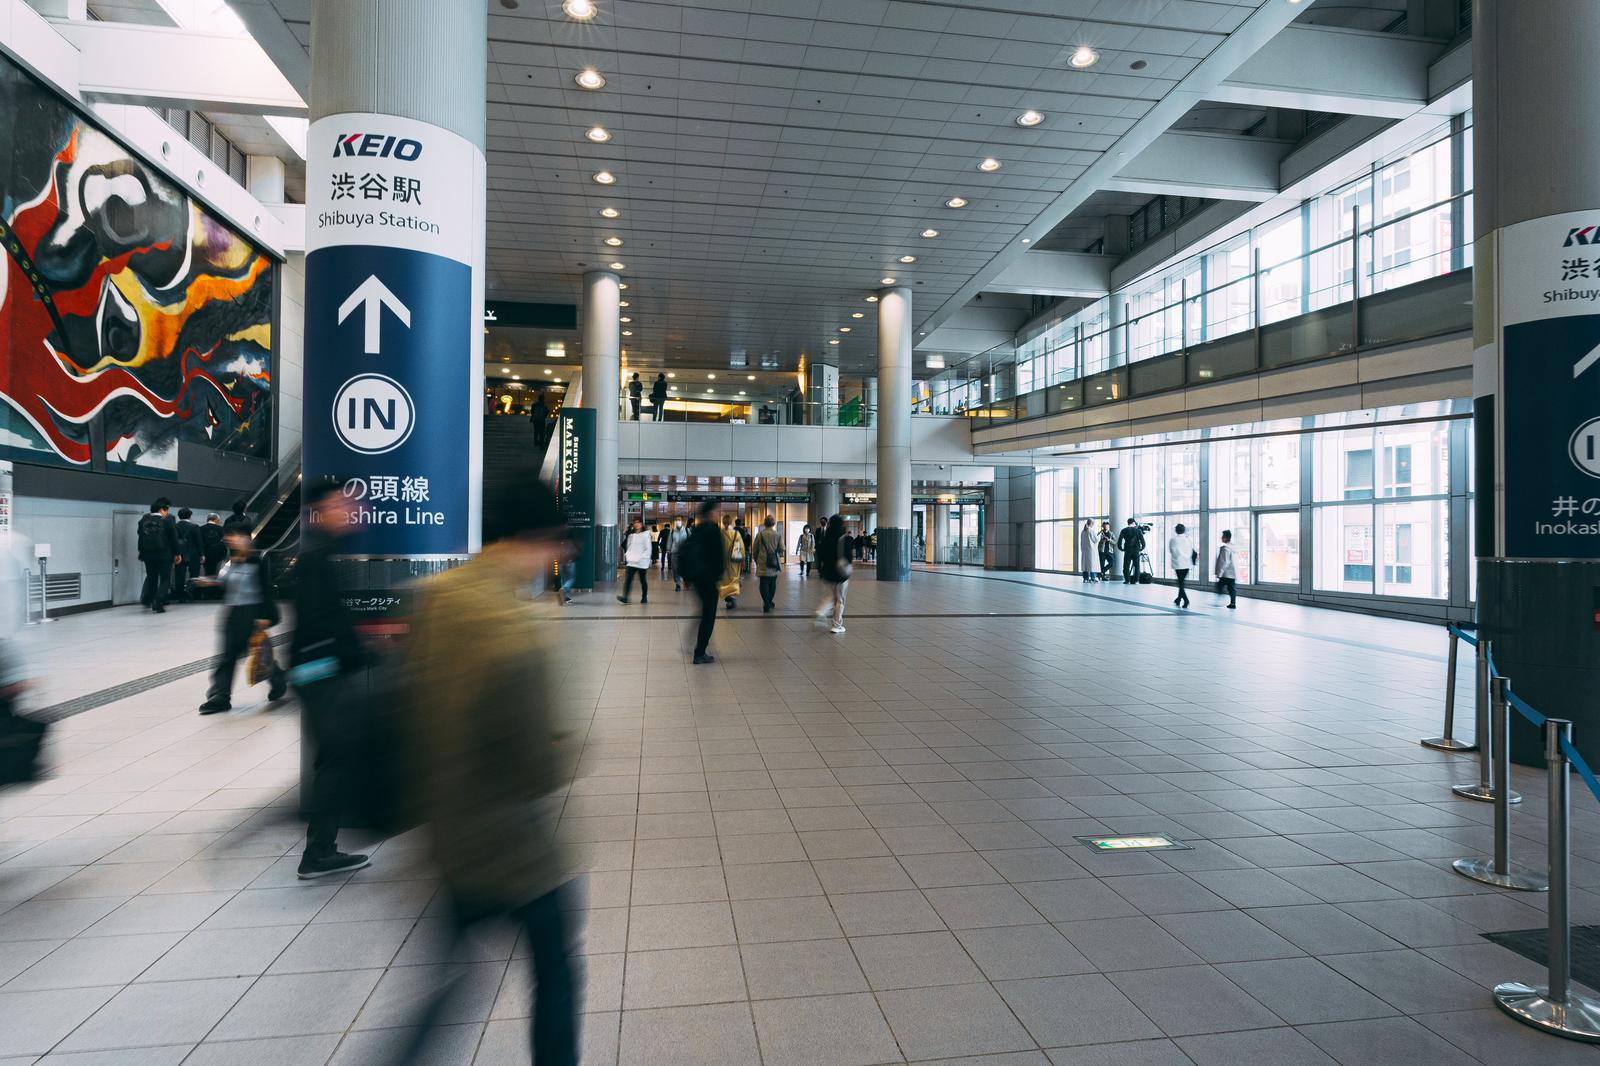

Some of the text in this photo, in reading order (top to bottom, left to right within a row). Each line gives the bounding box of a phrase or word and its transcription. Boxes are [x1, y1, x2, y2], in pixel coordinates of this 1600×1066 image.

[333, 133, 422, 162] KEIO
[331, 172, 422, 206] 渋谷駅
[318, 210, 440, 234] Shibuya Station
[1543, 288, 1600, 303] Shibuy
[348, 397, 396, 430] IN
[565, 417, 574, 492] MARK CITY
[323, 475, 430, 503] の頭線
[405, 507, 445, 525] Line
[1535, 520, 1600, 535] Inokas
